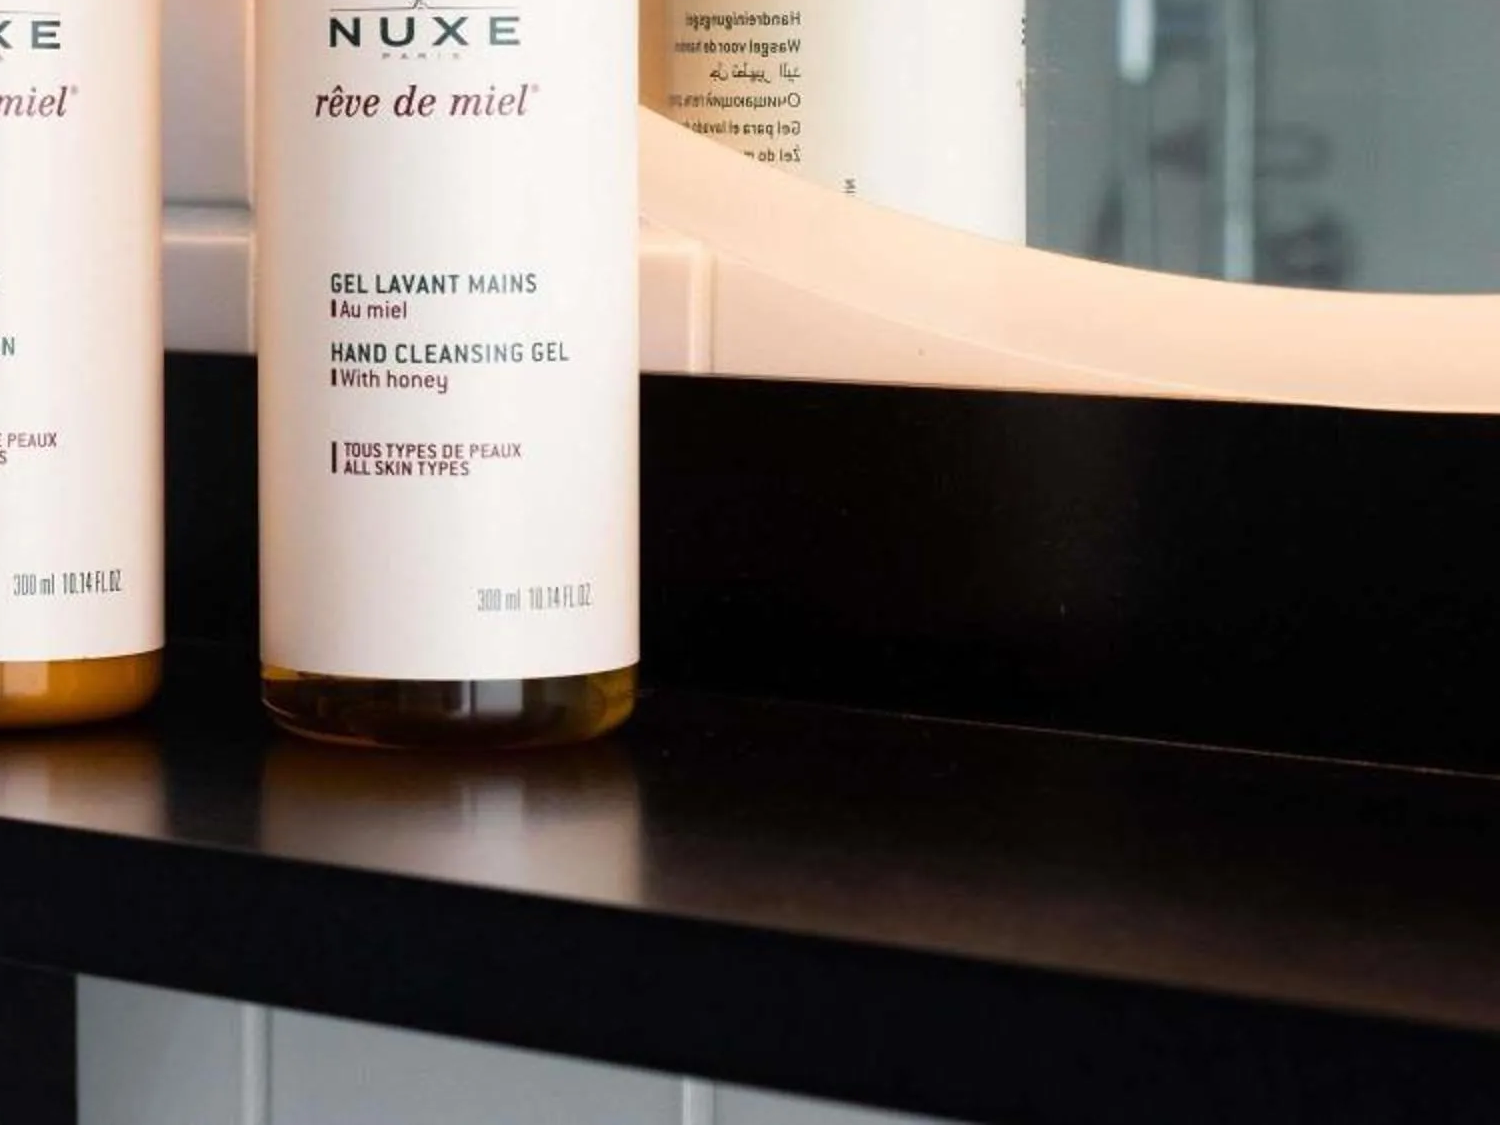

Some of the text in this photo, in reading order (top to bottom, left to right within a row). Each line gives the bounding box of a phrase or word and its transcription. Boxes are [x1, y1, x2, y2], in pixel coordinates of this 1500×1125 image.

[329, 16, 520, 48] NUXE
[316, 85, 380, 117] rêve
[393, 84, 436, 117] de
[331, 272, 537, 294] GEL LAVANT MAINS
[340, 300, 407, 320] Au miel
[331, 342, 569, 364] HAND CLEANSING GEL
[340, 368, 448, 394] With honey
[7, 432, 57, 448] PEAUX
[344, 442, 521, 460] TOUS TYPES DE PEAUX
[344, 461, 470, 476] ALL SKIN TYPES
[13, 573, 37, 596] 300
[39, 573, 55, 595] ml
[63, 571, 93, 595] 10.14
[477, 588, 502, 612] 300
[505, 587, 521, 612] ml
